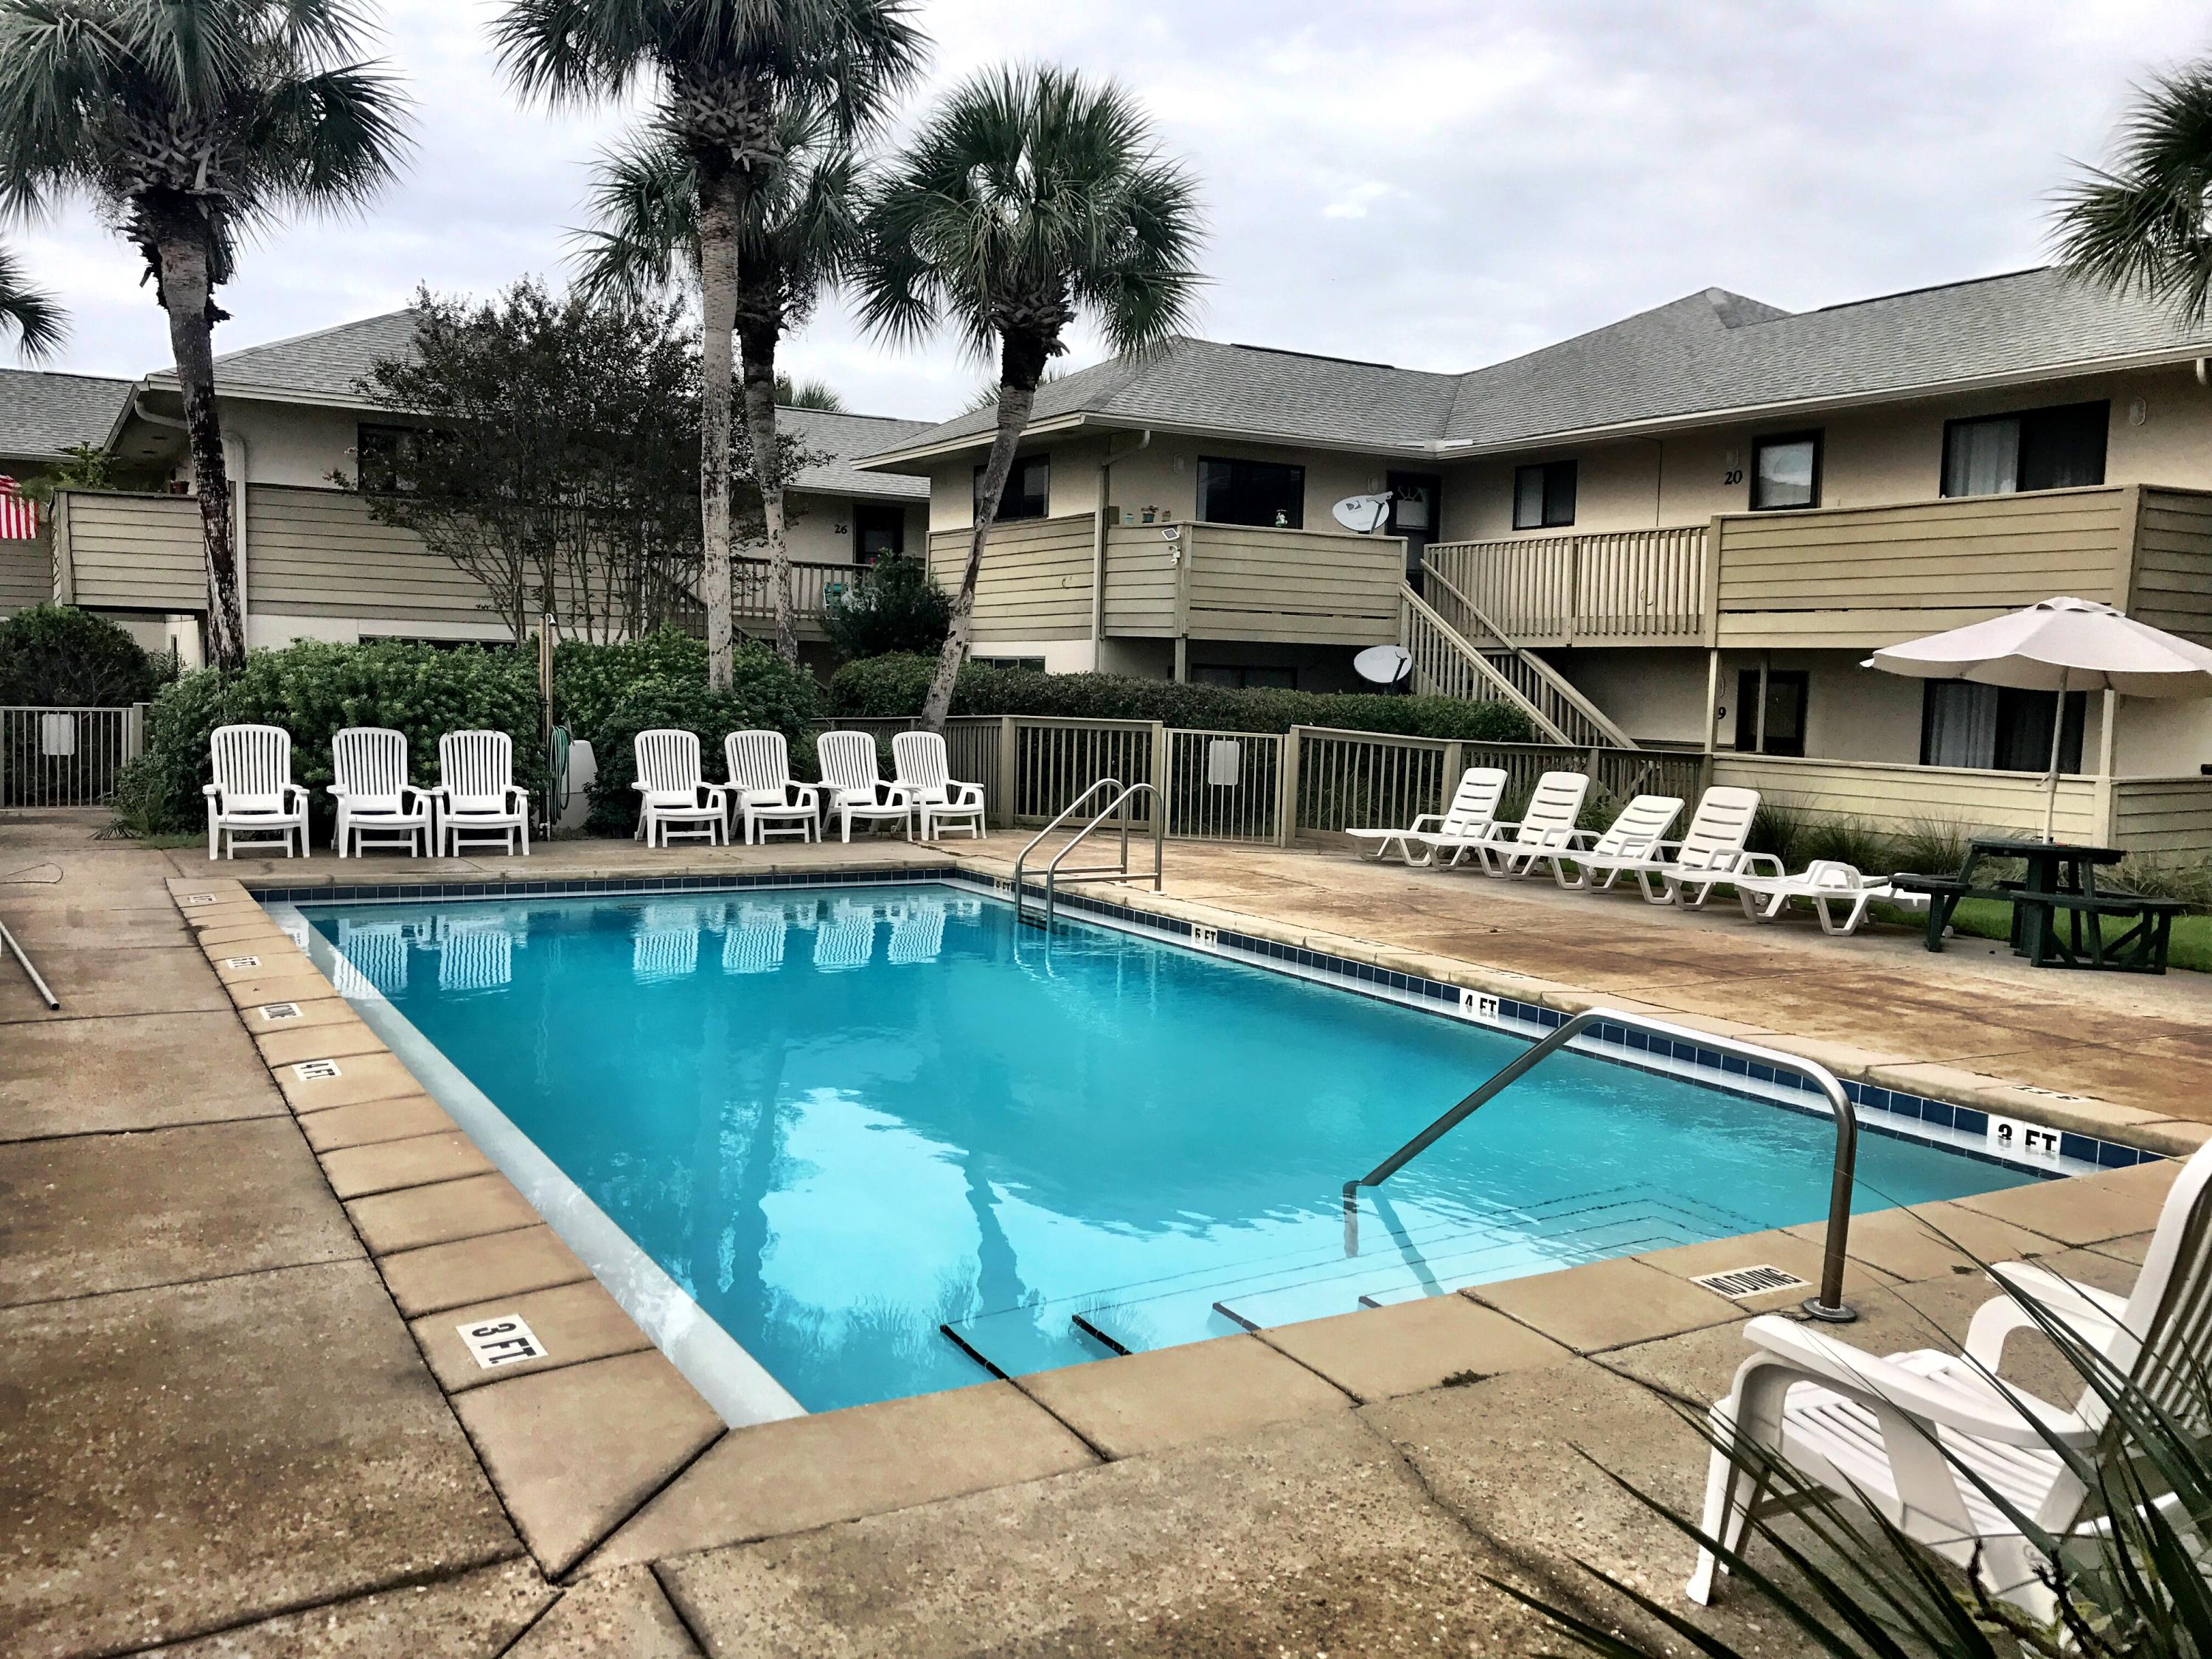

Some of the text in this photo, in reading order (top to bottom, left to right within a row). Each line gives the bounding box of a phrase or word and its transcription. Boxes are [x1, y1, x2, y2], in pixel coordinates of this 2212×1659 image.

[1724, 470, 1743, 485] 20
[834, 524, 848, 535] 26
[1204, 929, 1217, 942] FT
[1464, 994, 1497, 1012] 4 FT
[1997, 1123, 2013, 1141] 3
[1700, 1267, 1803, 1295] NO DIVING
[471, 1323, 517, 1337] 3
